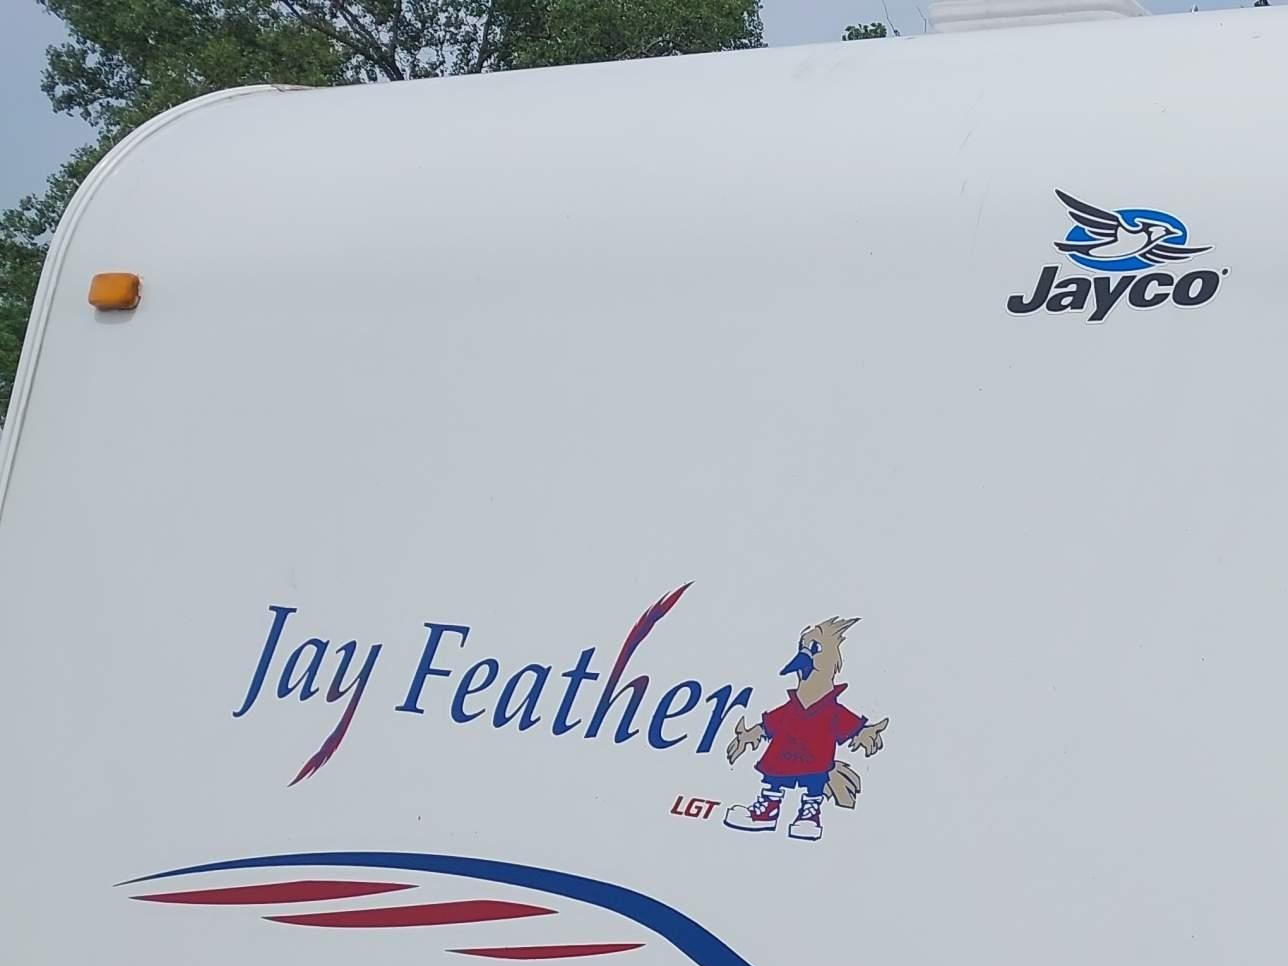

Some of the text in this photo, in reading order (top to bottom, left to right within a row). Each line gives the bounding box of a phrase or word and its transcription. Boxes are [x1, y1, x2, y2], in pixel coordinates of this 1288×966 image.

[1007, 265, 1217, 322] Jayco
[232, 580, 754, 787] Jay Feather
[670, 795, 722, 819] LGT
